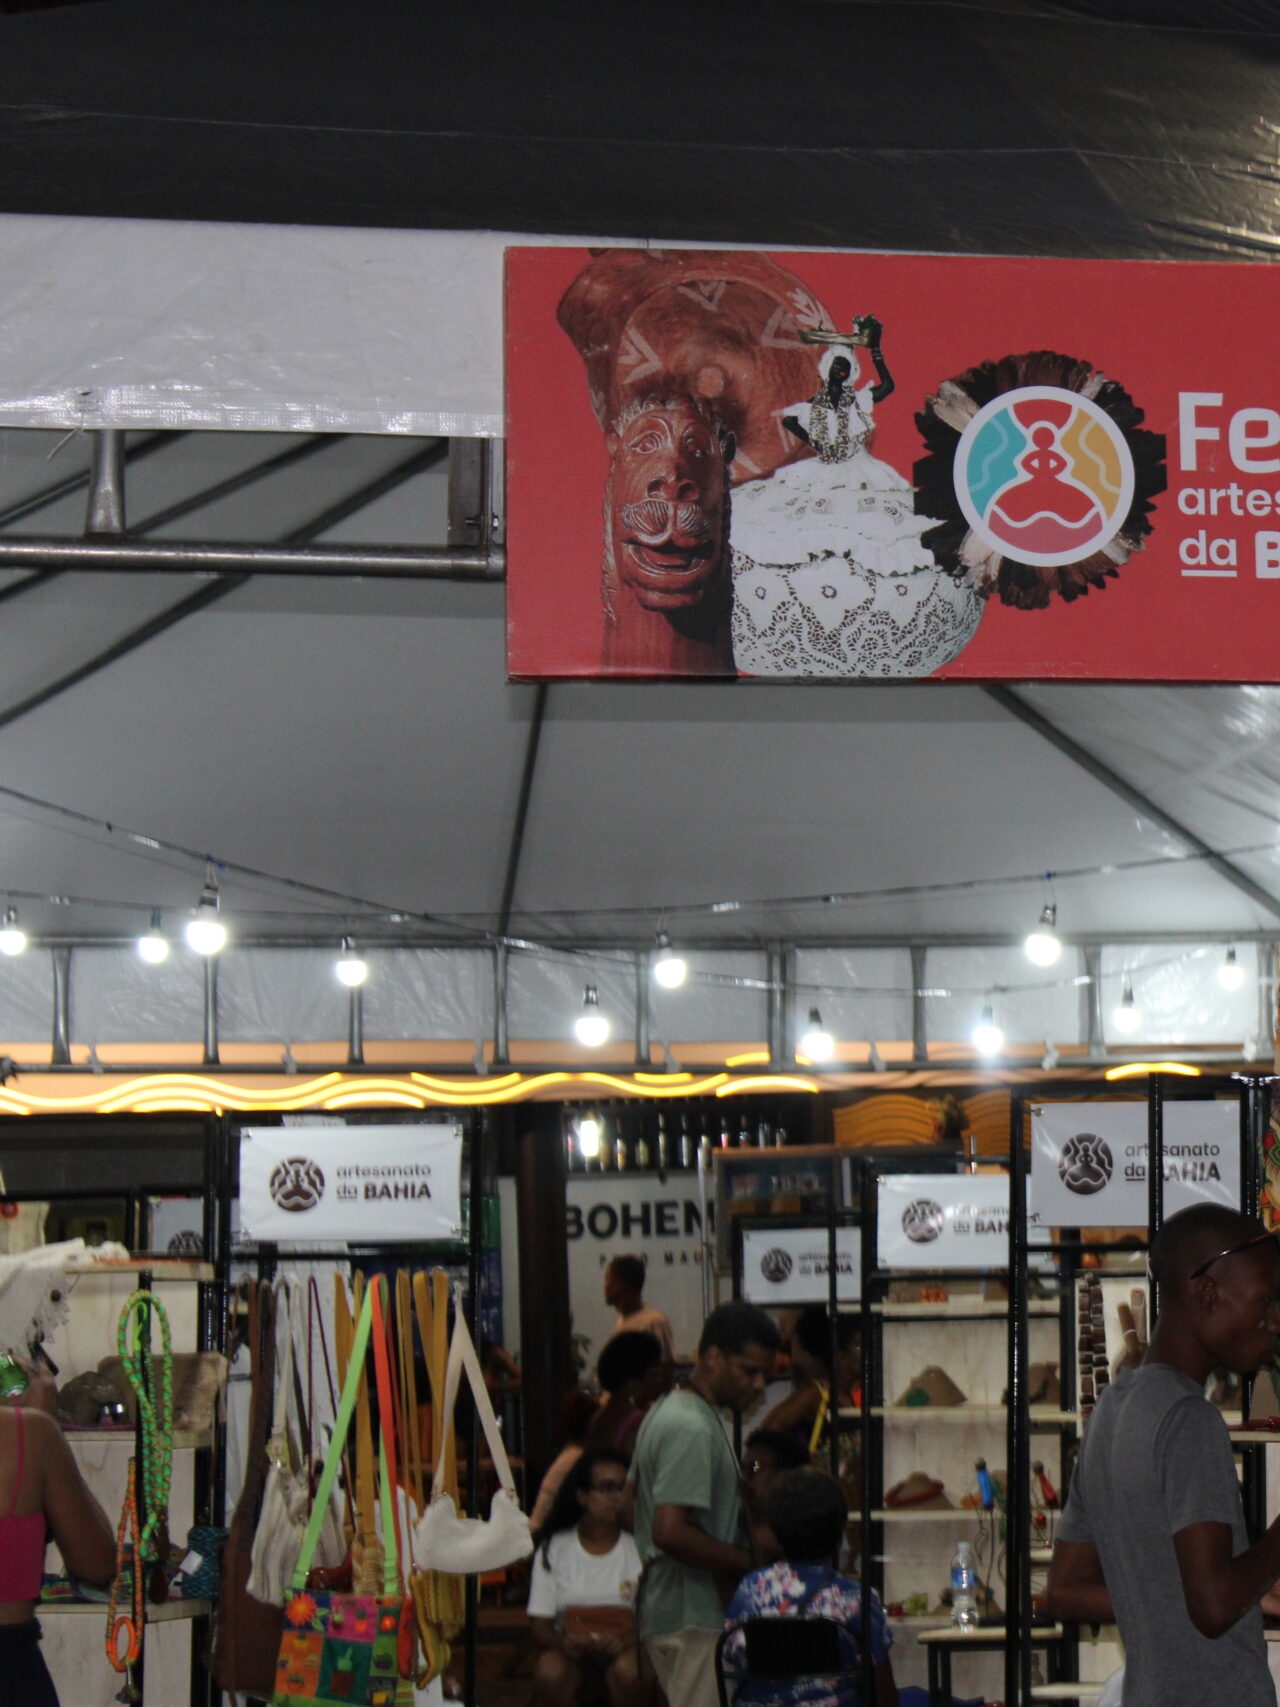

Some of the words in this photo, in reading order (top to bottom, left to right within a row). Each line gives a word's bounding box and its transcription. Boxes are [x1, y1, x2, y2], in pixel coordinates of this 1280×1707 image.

[1178, 529, 1239, 567] da
[1125, 1143, 1220, 1157] artsanato
[336, 1164, 431, 1177] artesanato
[1124, 1163, 1146, 1177] da
[1162, 1162, 1221, 1181] AHIA
[336, 1183, 358, 1196] da
[363, 1181, 431, 1199] BAHIA
